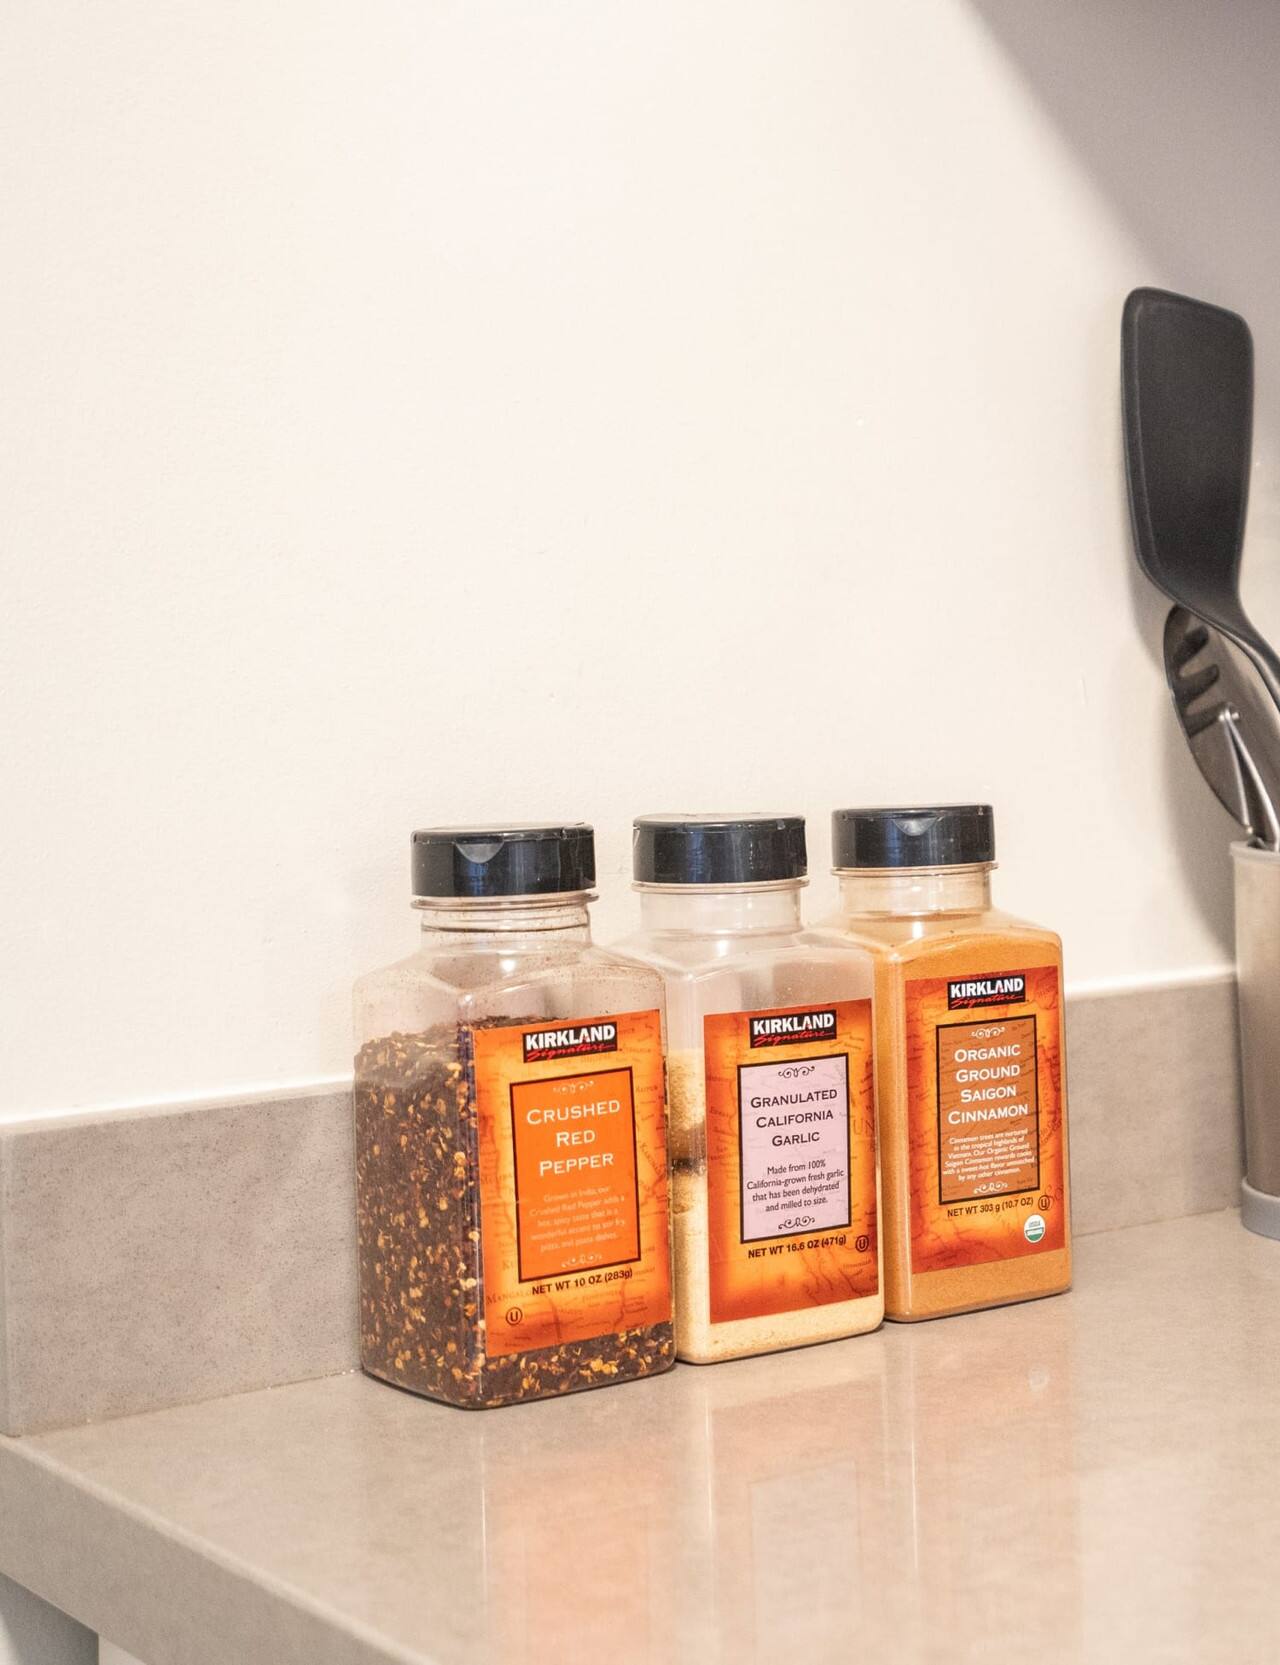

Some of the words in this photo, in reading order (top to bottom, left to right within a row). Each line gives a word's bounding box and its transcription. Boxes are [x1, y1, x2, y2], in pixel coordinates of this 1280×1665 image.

[950, 977, 1024, 998] KIRKLAND
[753, 1013, 834, 1036] KIRKLAND
[525, 1024, 616, 1050] KIRKLAND
[754, 1030, 836, 1047] Signature
[527, 1043, 615, 1061] Signature
[767, 1166, 787, 1175] Made
[788, 1163, 806, 1172] from
[808, 1159, 826, 1170] 100%
[746, 1177, 807, 1190] California-grown
[808, 1171, 825, 1182] fresh
[826, 1168, 845, 1180] garlic
[752, 1193, 767, 1202] that
[769, 1190, 781, 1200] has
[783, 1187, 800, 1198] been
[802, 1181, 840, 1195] dehydrated
[765, 1203, 779, 1212] and
[780, 1199, 802, 1210] milled
[948, 1208, 963, 1217] NET
[965, 1205, 978, 1214] WT
[980, 1204, 994, 1213] 303
[995, 1204, 1000, 1212] g
[1001, 1199, 1019, 1211] (10.7
[1020, 1197, 1034, 1206] OZ)
[748, 1248, 767, 1258] NET
[769, 1245, 784, 1254] WT
[807, 1240, 820, 1249] OZ
[821, 1234, 847, 1248] (471g)
[532, 1284, 552, 1295] NET
[555, 1280, 571, 1291] WT
[574, 1278, 586, 1287] 10
[588, 1275, 602, 1284] OZ
[604, 1268, 633, 1283] (283g)
